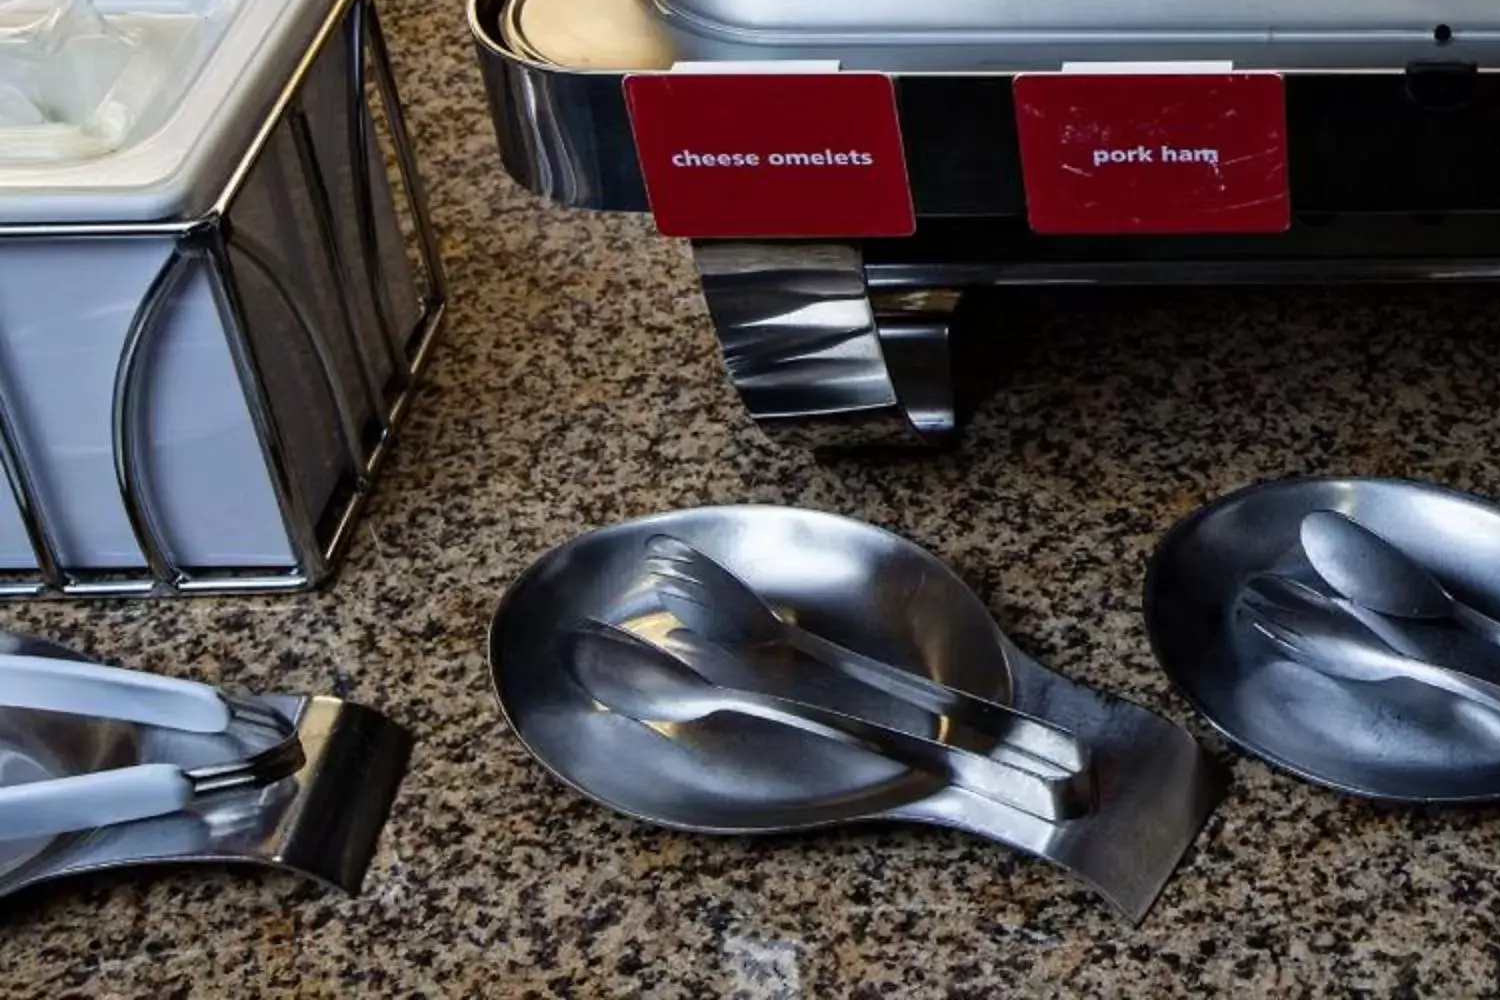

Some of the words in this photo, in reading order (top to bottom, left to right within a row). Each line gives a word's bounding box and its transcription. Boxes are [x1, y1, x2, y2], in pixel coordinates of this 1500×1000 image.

[672, 147, 758, 168] cheese
[769, 147, 873, 168] omelets
[1093, 145, 1153, 167] pork
[1161, 145, 1219, 164] ham
